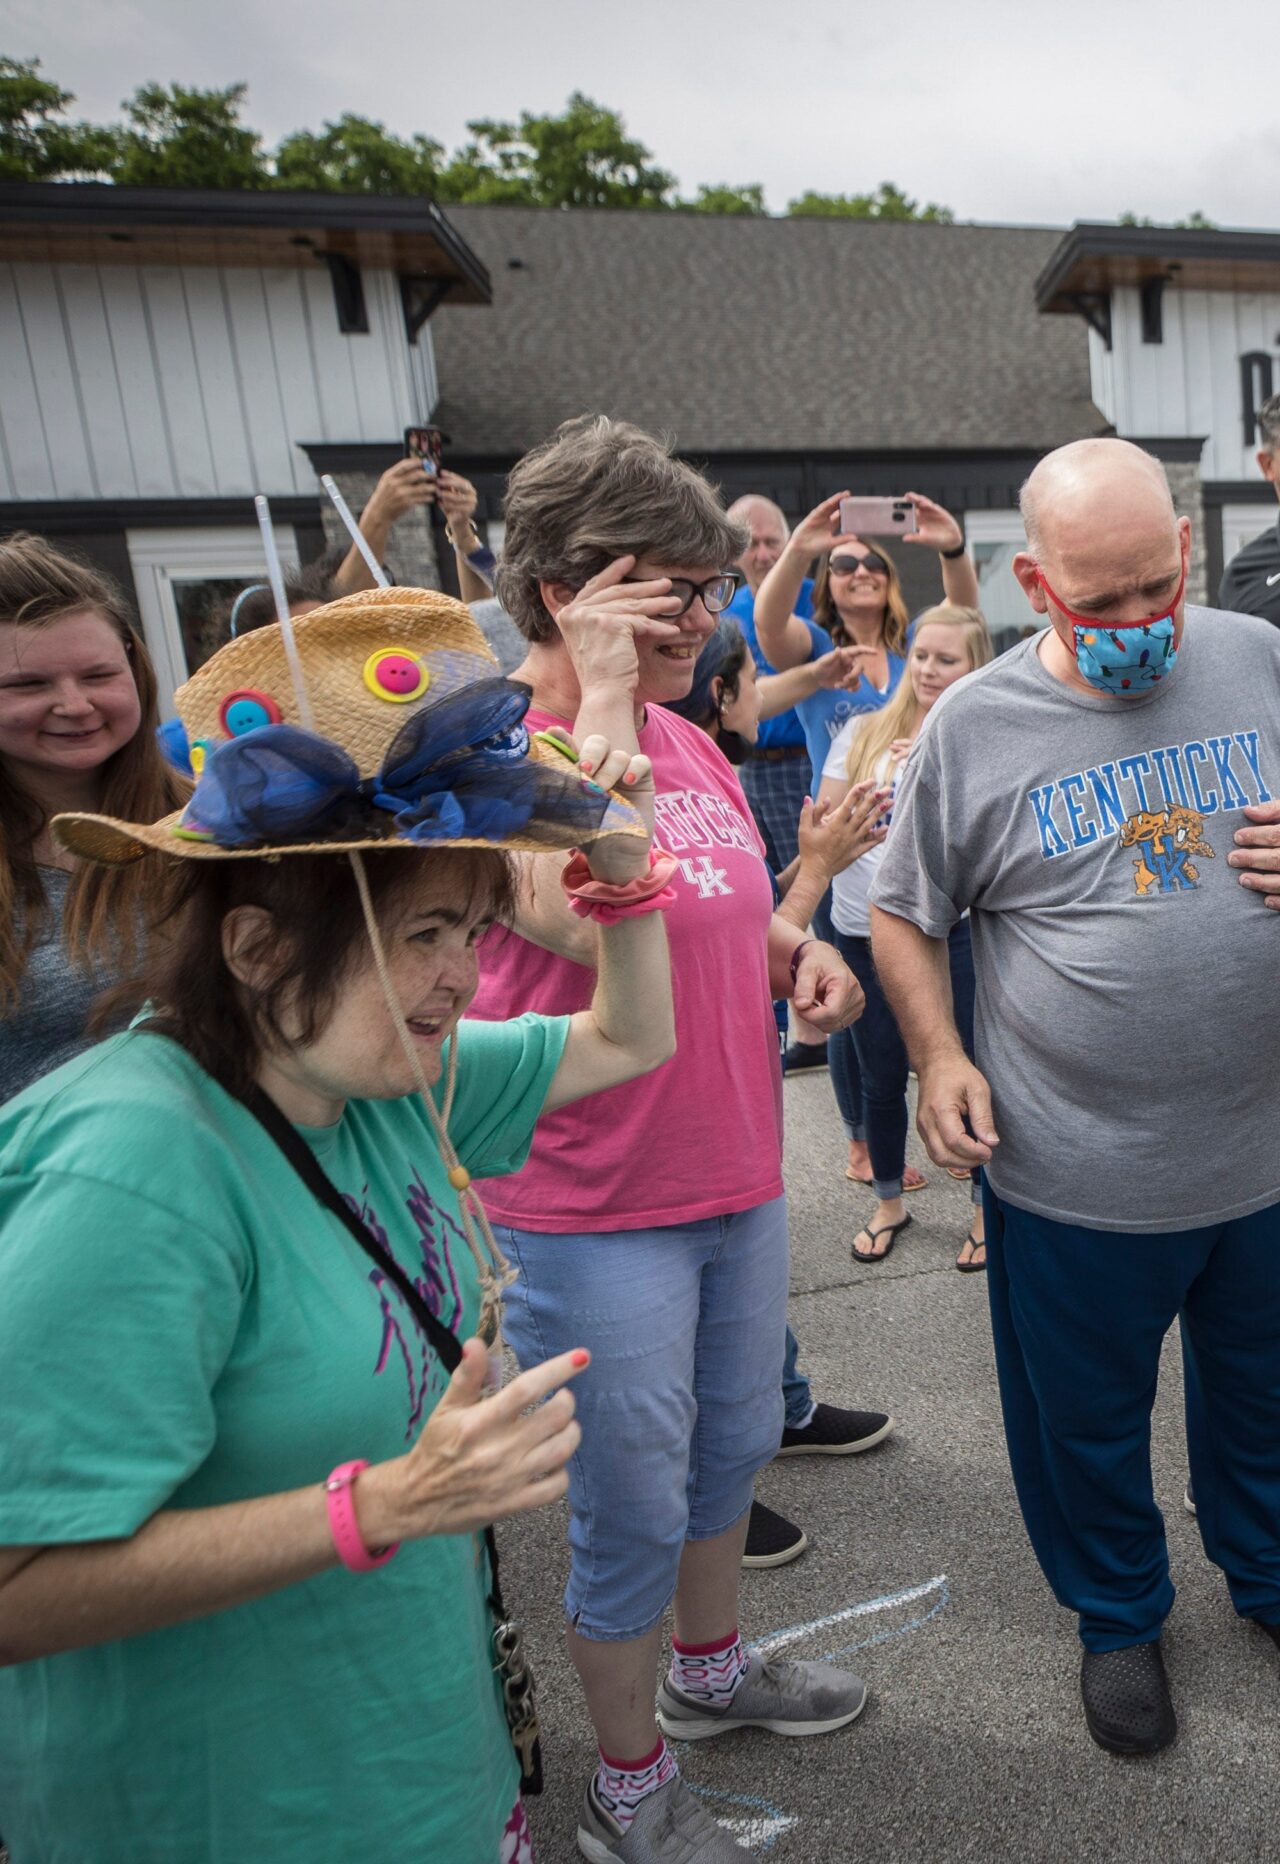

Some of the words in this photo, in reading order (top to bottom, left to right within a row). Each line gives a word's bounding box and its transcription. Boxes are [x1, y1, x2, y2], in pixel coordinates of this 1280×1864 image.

[1027, 730, 1274, 861] KENTUCKY
[677, 855, 736, 899] UK
[1139, 834, 1198, 893] UK
